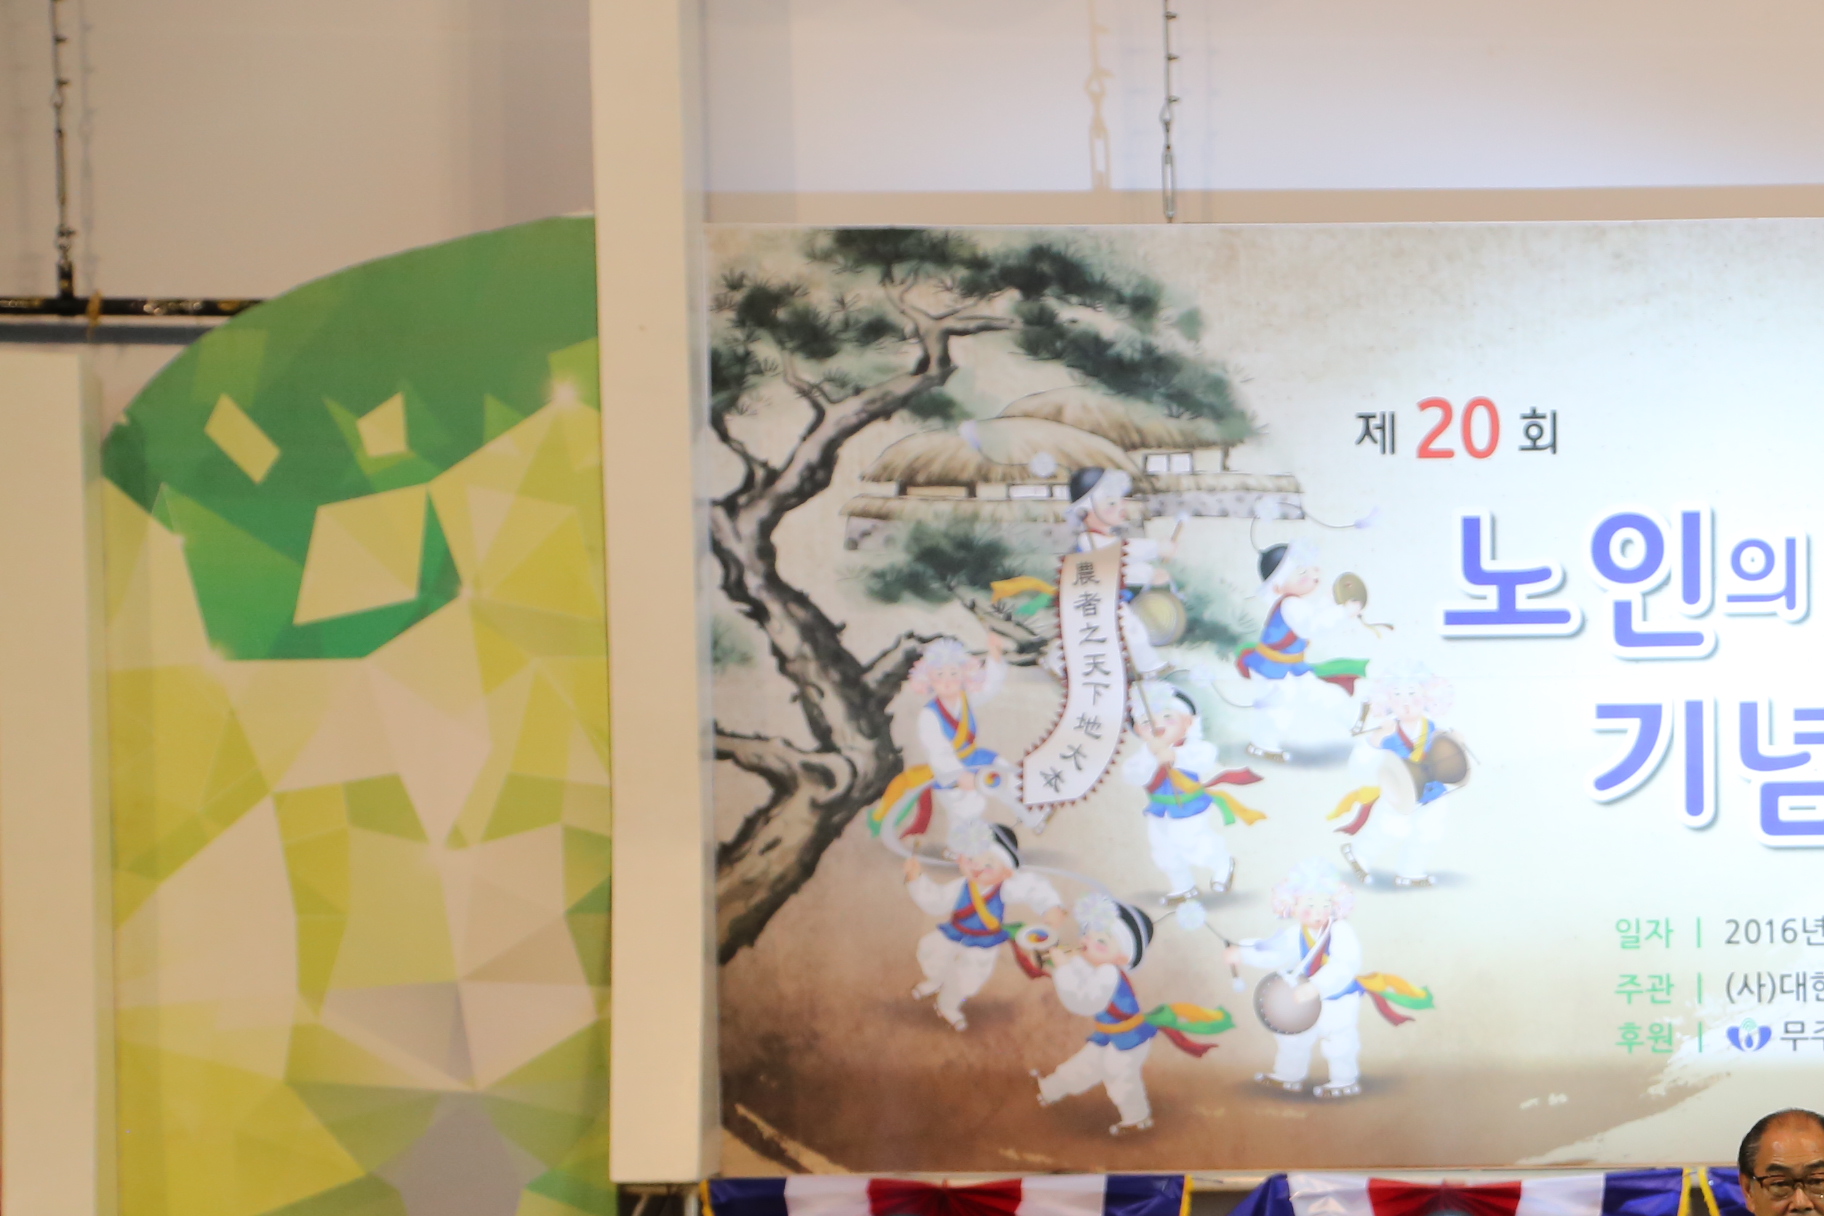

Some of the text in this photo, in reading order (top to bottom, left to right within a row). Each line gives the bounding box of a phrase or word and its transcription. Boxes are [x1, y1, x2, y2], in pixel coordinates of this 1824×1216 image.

[1442, 508, 1800, 650] 노인의
[1614, 917, 1673, 949] 일자
[1614, 973, 1675, 1005] 주관
[1614, 1021, 1674, 1054] 후원
